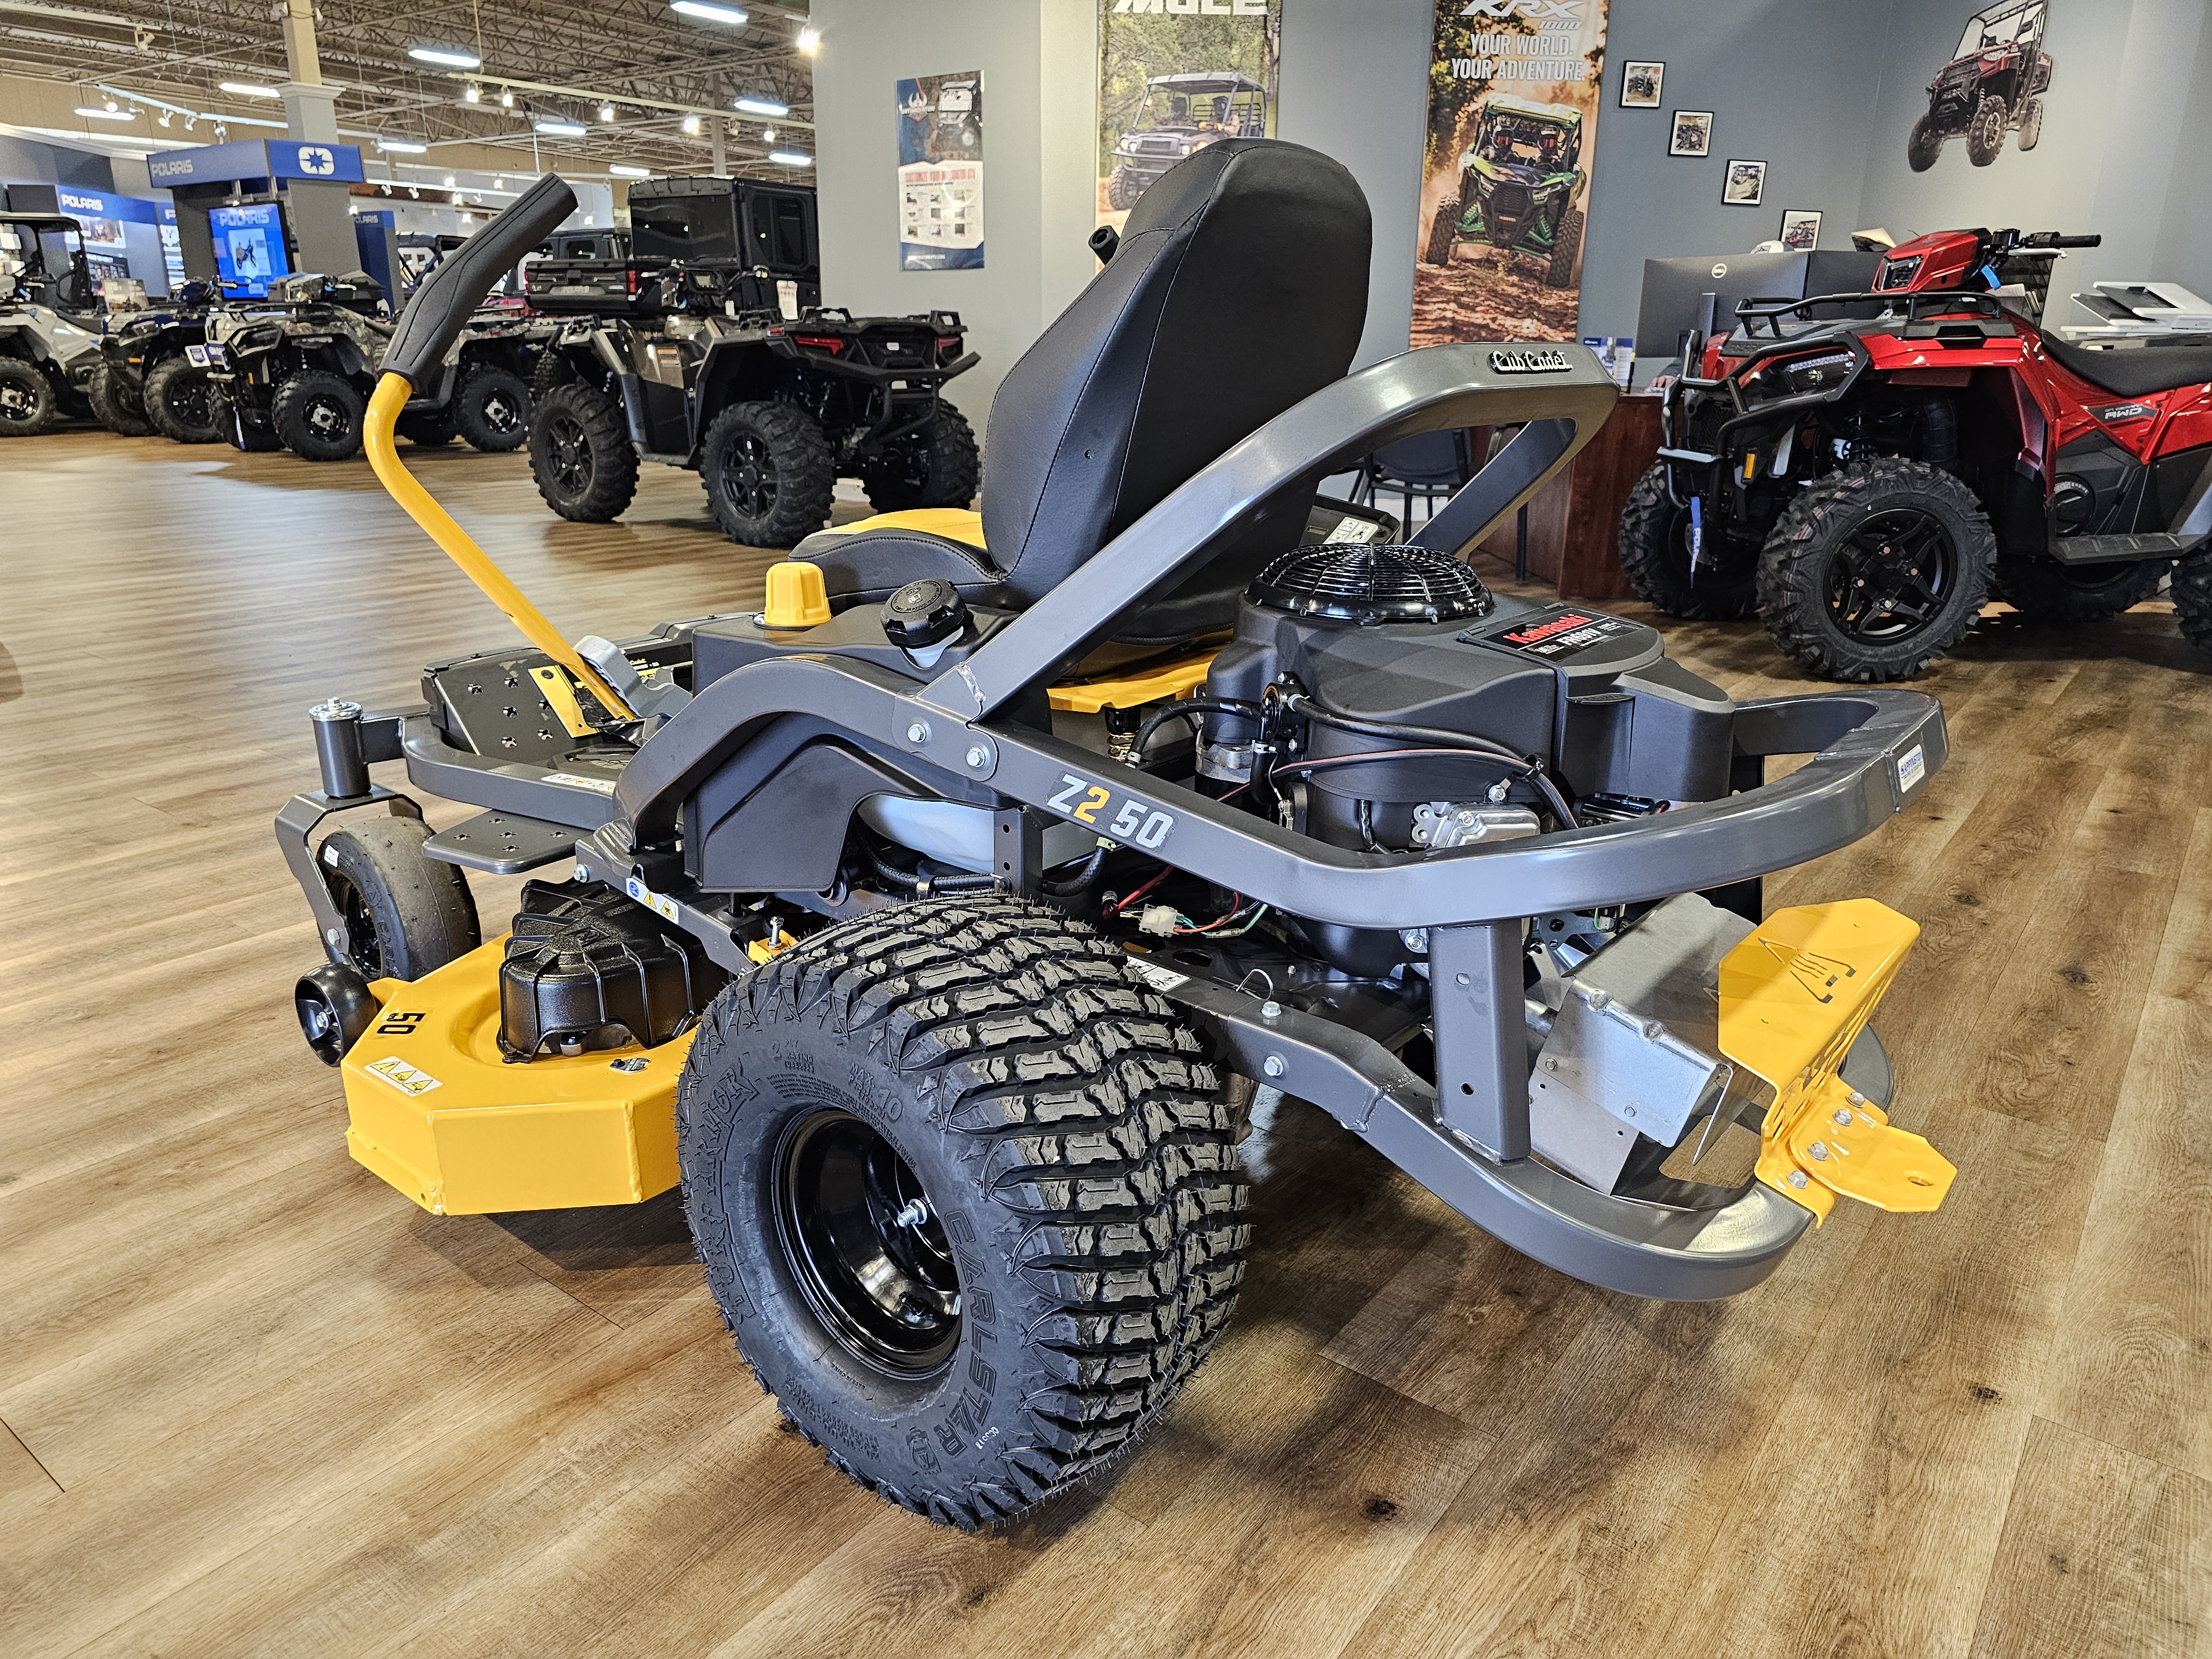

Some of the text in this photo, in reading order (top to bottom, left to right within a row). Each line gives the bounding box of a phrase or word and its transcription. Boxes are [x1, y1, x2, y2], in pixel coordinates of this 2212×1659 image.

[1538, 20, 1582, 30] 1000
[1470, 34, 1573, 56] YOUR WORLD.
[1452, 58, 1585, 81] YOUR ADVENTURE.
[152, 159, 194, 178] POLARIS
[61, 194, 103, 211] POLARIS
[220, 208, 270, 226] POLARIS
[1492, 350, 1525, 372] Cub
[2105, 407, 2142, 419] AWD
[1503, 613, 1593, 644] Kawasaki
[1110, 799, 1173, 848] 50
[376, 1013, 426, 1035] 50
[878, 1088, 903, 1121] 10
[933, 1210, 998, 1458] CARLSTAR
